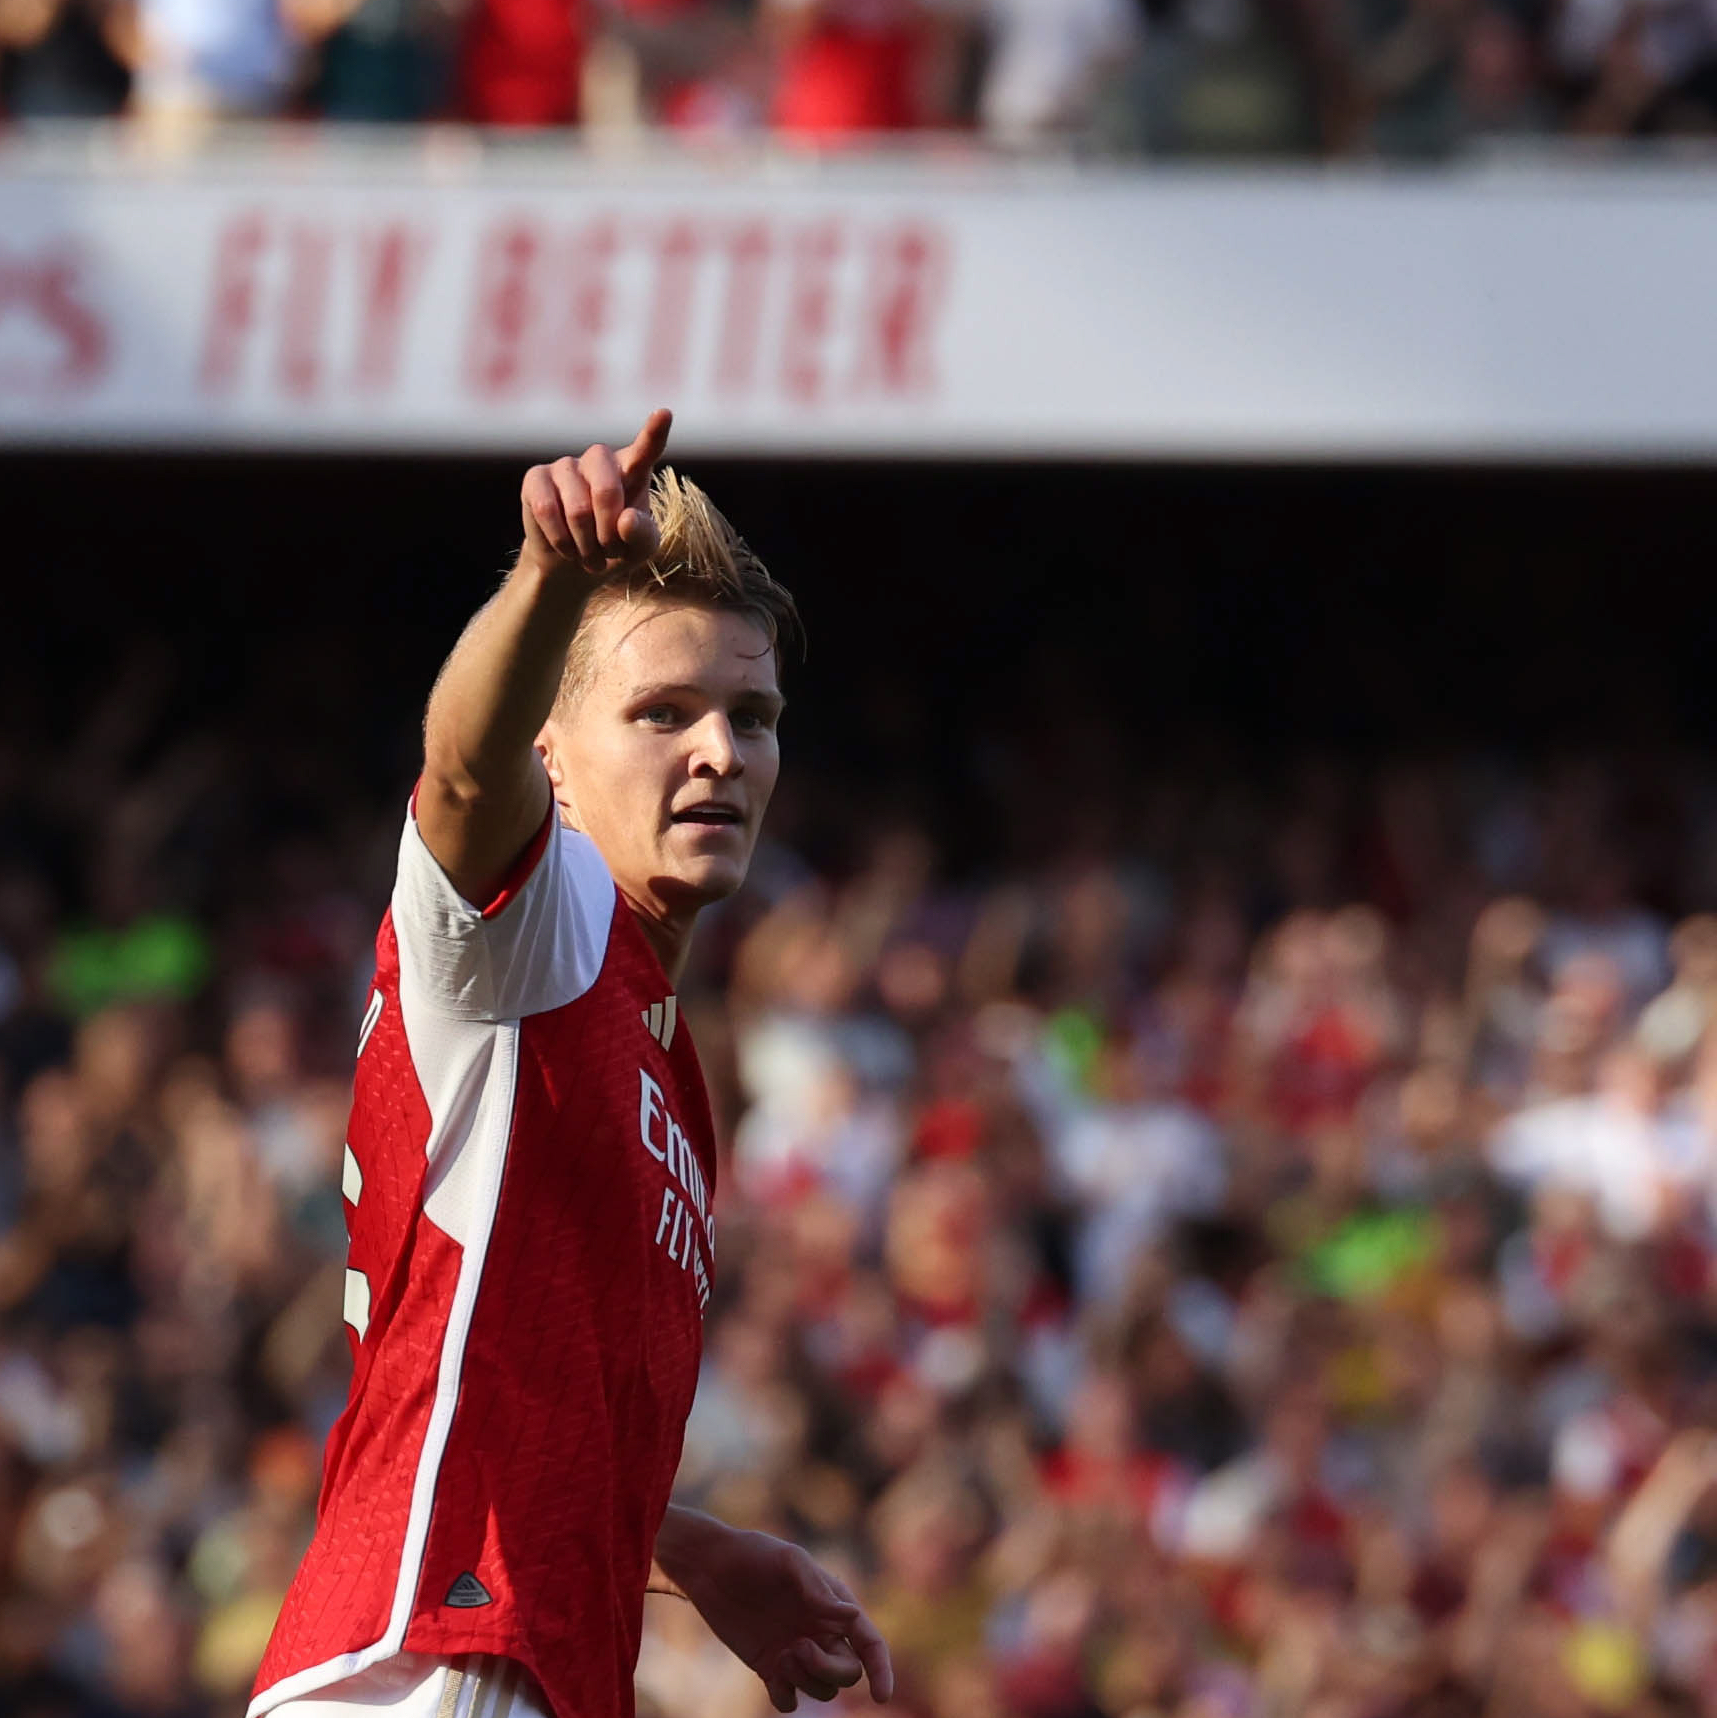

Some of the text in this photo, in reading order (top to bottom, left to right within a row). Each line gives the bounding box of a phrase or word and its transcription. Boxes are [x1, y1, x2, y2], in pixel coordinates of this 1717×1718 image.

[195, 203, 957, 404] FLY BETTER
[654, 1186, 694, 1271] FLY
